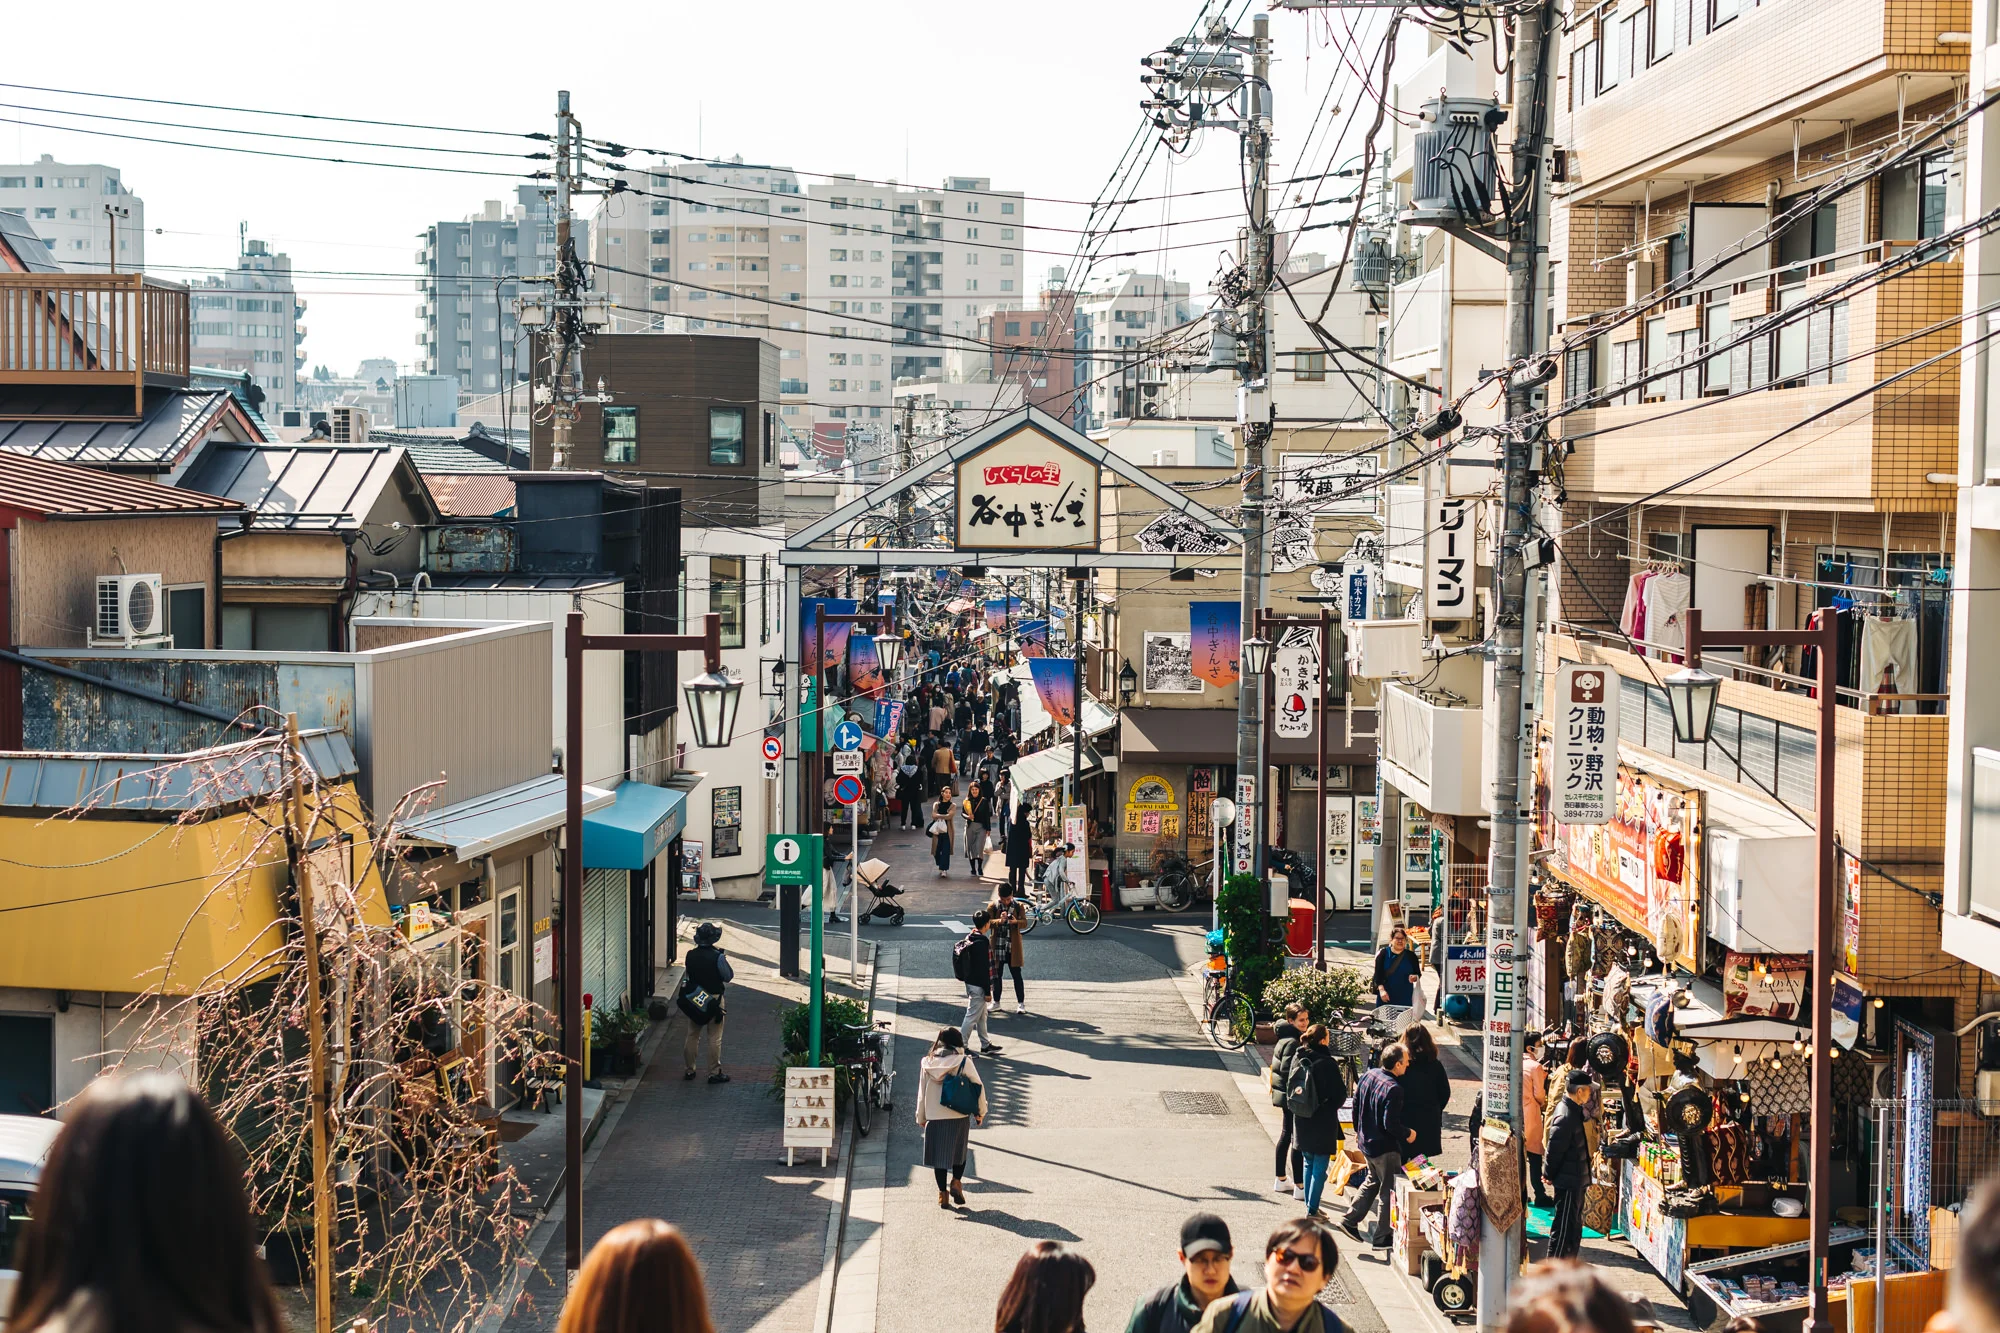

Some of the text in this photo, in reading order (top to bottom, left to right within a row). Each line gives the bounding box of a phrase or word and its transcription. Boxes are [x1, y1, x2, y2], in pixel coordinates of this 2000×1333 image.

[984, 461, 1060, 486] ひぐらしの里
[969, 481, 1087, 538] 谷中ぎんざ
[1207, 612, 1221, 679] 谷中ぎんざ
[1297, 654, 1309, 691] かき氷
[1279, 722, 1309, 732] ひみつ堂
[1566, 706, 1584, 790] クリニック
[1585, 706, 1606, 791] 動物・野沢
[1157, 777, 1173, 797] PRODUCTS
[1563, 810, 1604, 819] 3894-7739
[533, 916, 551, 935] CAFE
[1459, 948, 1485, 959] Asahi
[1455, 965, 1486, 982] 焼肉
[787, 1074, 830, 1089] CAFE
[806, 1095, 826, 1107] LA
[787, 1114, 831, 1128] PAPA
